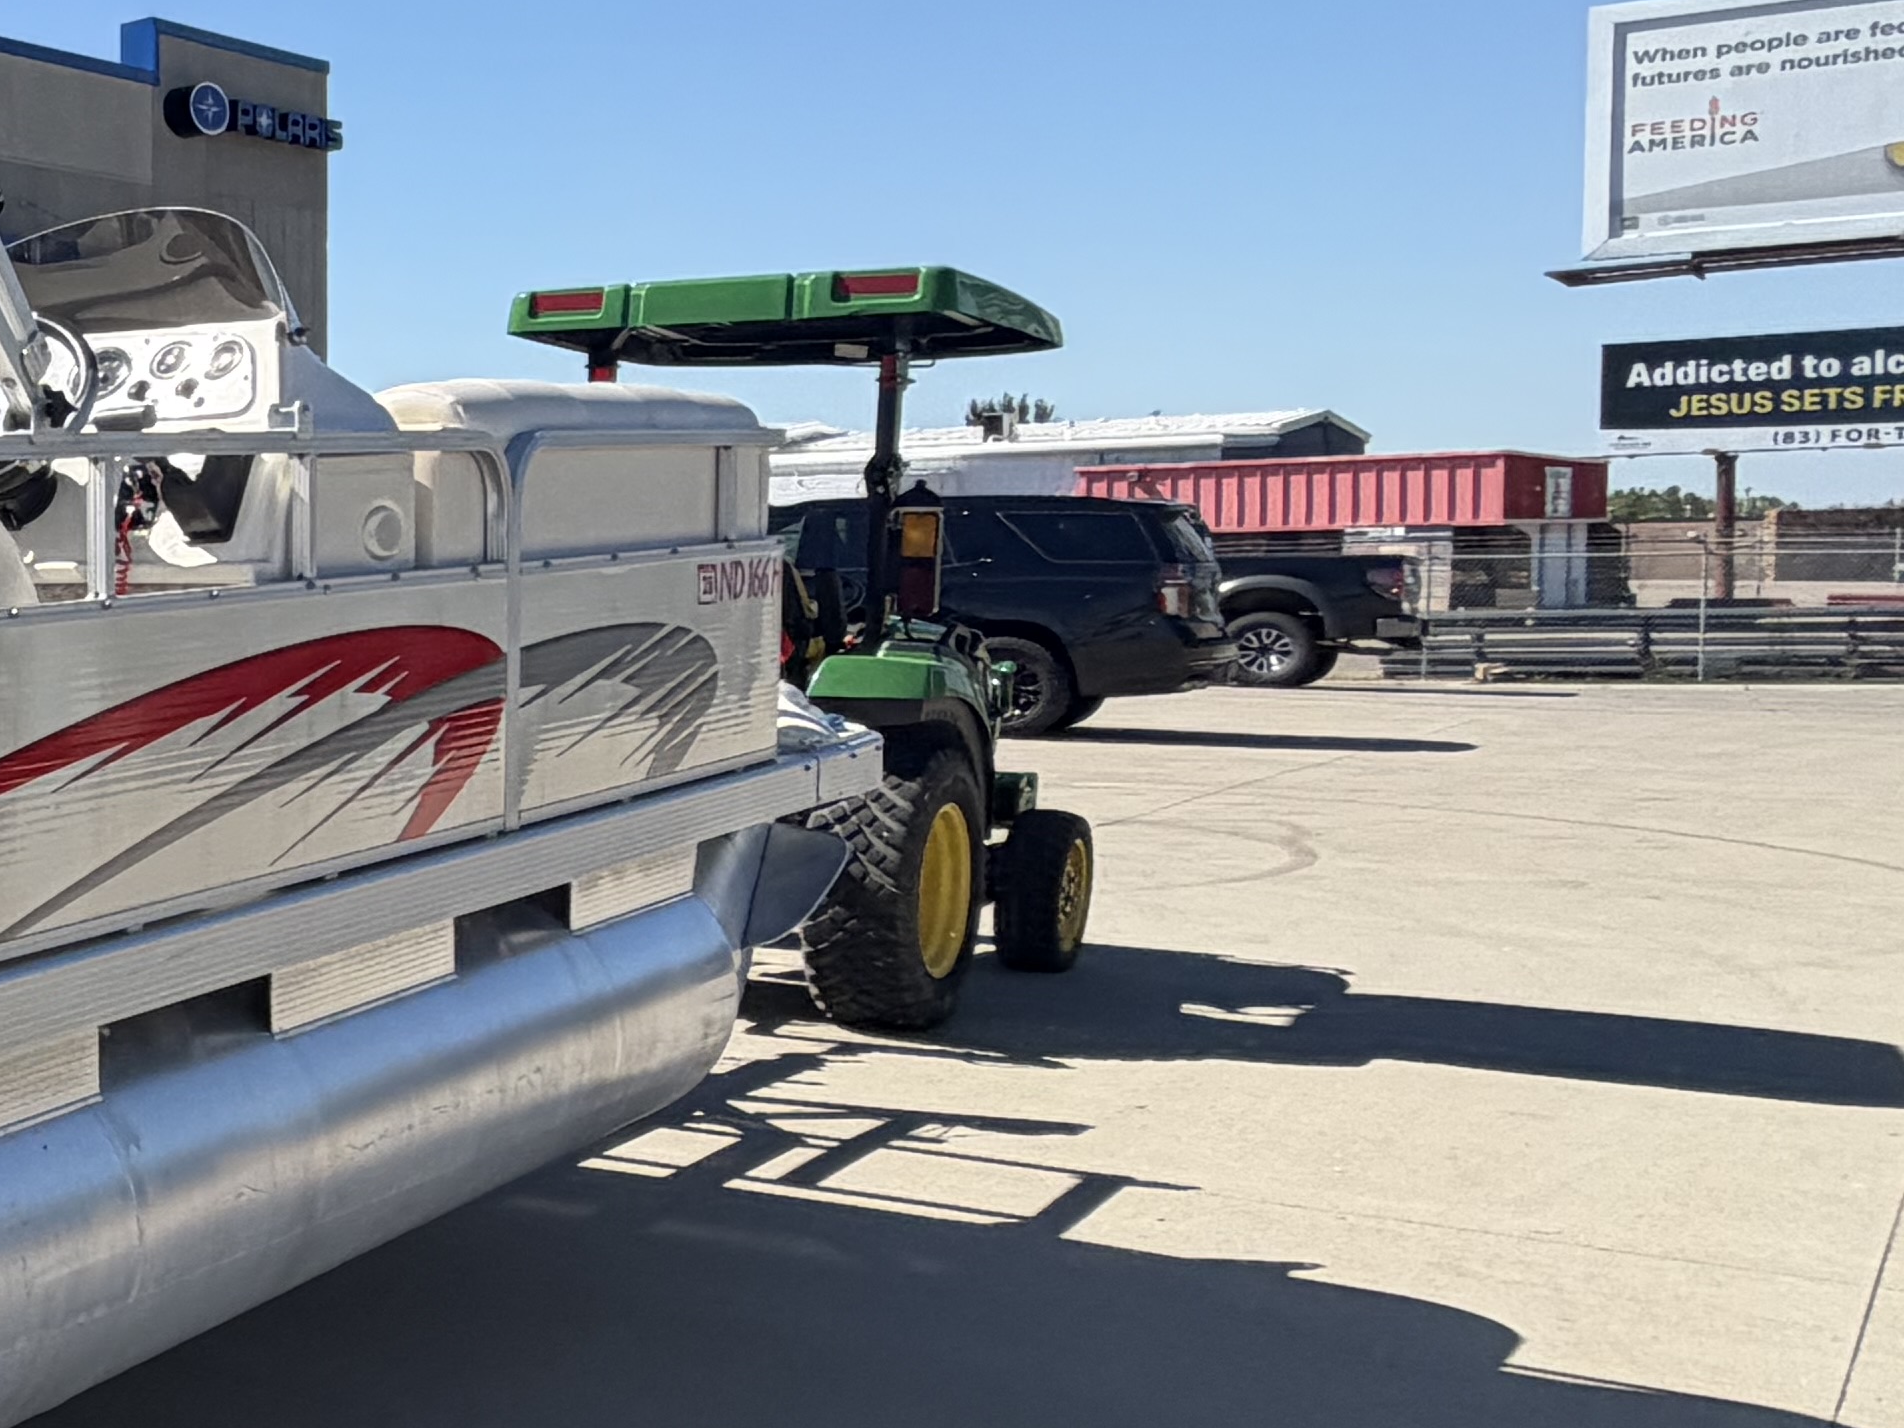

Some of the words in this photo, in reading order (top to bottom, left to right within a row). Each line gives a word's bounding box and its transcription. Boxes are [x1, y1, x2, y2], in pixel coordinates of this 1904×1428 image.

[1632, 44, 1707, 65] When
[1716, 31, 1809, 59] people
[1816, 27, 1861, 45] are
[1631, 66, 1721, 88] futures
[1729, 61, 1771, 77] are
[237, 100, 343, 152] POLARIS
[1631, 111, 1759, 138] FEEDING
[1627, 128, 1760, 154] AMERICA
[1626, 354, 1792, 388] Addicted
[1802, 354, 1842, 378] to
[1669, 390, 1774, 418] JESUS
[1780, 387, 1865, 412] SETS
[1772, 430, 1821, 445] (83)
